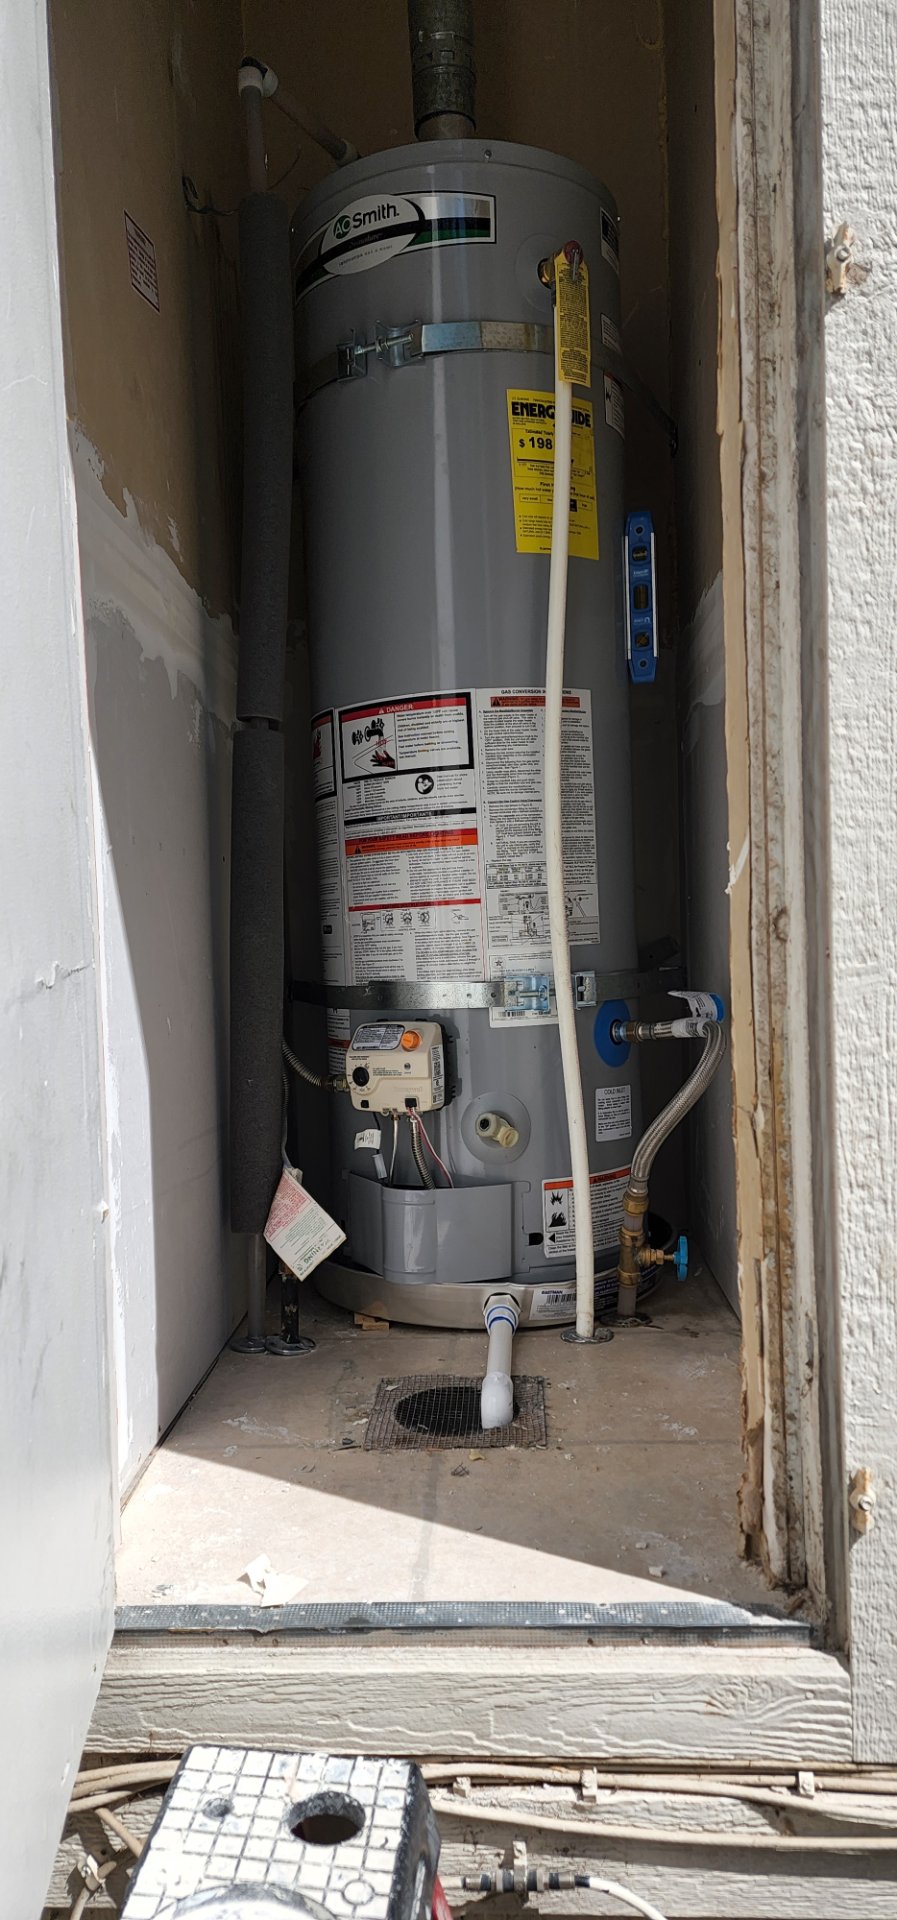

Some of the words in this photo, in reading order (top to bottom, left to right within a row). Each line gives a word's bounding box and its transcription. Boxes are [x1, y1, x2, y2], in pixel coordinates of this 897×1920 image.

[519, 438, 526, 448] $
[529, 436, 553, 449] 198
[386, 704, 413, 713] DANGER
